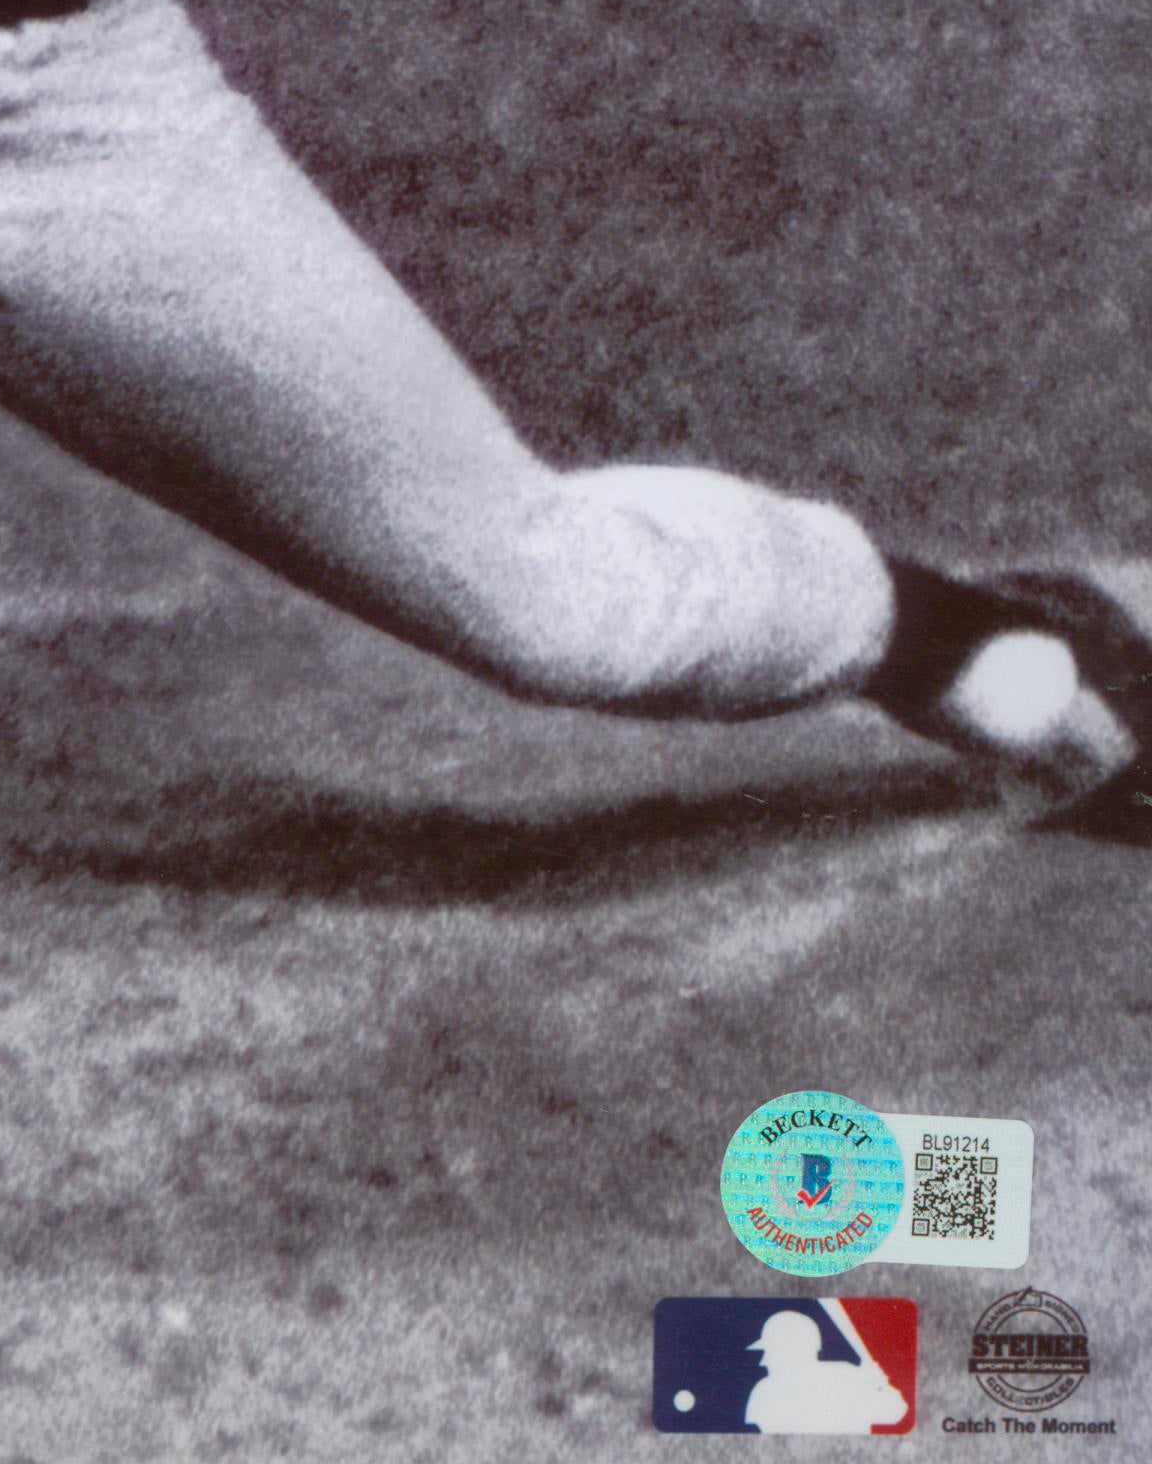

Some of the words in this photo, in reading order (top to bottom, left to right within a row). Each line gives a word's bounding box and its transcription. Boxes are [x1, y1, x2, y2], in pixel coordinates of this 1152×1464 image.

[759, 1109, 873, 1147] BECKETT
[922, 1134, 990, 1153] BL91214
[746, 1206, 873, 1255] AUTHENTICATED
